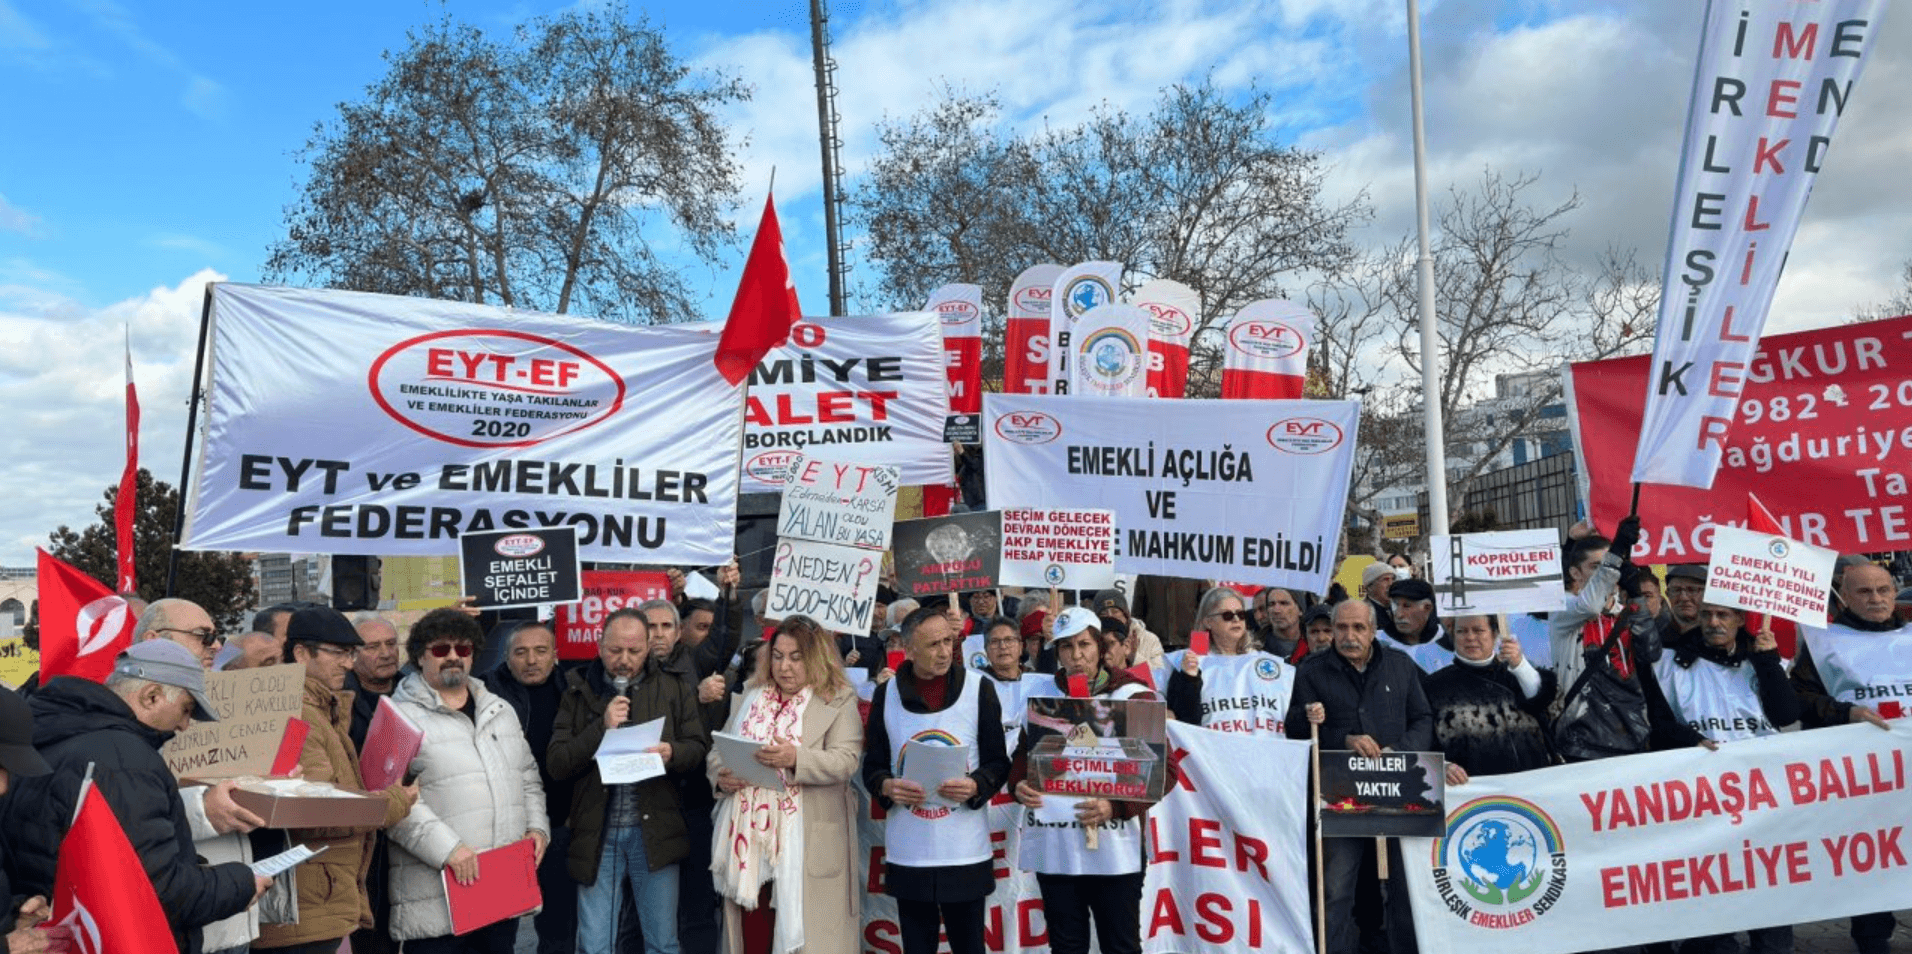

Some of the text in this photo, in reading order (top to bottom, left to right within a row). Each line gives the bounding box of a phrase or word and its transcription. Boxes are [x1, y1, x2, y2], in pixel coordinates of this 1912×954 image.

[1697, 0, 1820, 452] MEKLİLER
[1249, 325, 1287, 338] EYT
[427, 348, 580, 387] EYT-EF
[400, 384, 599, 408] EMEKLİLİKTE YAŞA TAKILANLAR
[407, 401, 588, 420] VE EMEKLİLER FEDERASYONU
[471, 419, 531, 437] 2020
[1012, 415, 1044, 427] EYT
[1286, 423, 1324, 435] EYT
[745, 426, 893, 450] BORÇLANDIK
[1717, 426, 1912, 473] ağduriye
[1067, 441, 1253, 487] EMEKLİ AÇLIĞA
[239, 453, 350, 494] EYT
[366, 466, 422, 493] ve
[438, 458, 709, 504] EMEKLİLER
[1146, 490, 1176, 520] VE
[782, 502, 838, 538] YALAN
[1004, 509, 1110, 523] SEÇİM GELECEK
[1004, 523, 1111, 537] DEVRAN DÖNECEK
[1004, 537, 1110, 550] AKP EMEKLİYE
[1129, 529, 1234, 564] MAHKUM
[1242, 532, 1323, 574] EDİLDİ
[490, 555, 552, 574] EMEKLİ
[1004, 550, 1112, 564] HESAP VERECEK.
[1467, 550, 1554, 565] KÖPRÜLERİ
[1485, 564, 1539, 577] YIKTIK
[1731, 554, 1816, 583] EMEKLİ YILI
[484, 571, 558, 589] SEFALET
[912, 576, 992, 594] PATLATTIK
[1713, 566, 1826, 601] OLACAK DEDİNİZ
[494, 586, 550, 603] İÇİNDE
[1786, 593, 1825, 613] KEFEN
[1738, 595, 1799, 617] BİÇTİNİZ
[1201, 693, 1278, 715] BİRLEŞİK
[229, 719, 277, 740] CENAZE
[168, 744, 249, 774] NAMAZINA
[1052, 758, 1140, 775] SEÇİMLERİ
[1348, 754, 1407, 772] GEMİLERİ
[1044, 778, 1147, 798] BEKLİYORUZ
[1355, 781, 1401, 797] YAKTIK
[1580, 749, 1906, 824] YANDAŞA BALLI
[1600, 826, 1908, 908] EMEKLİYE YOK
[1432, 853, 1567, 929] BİRLEŞİK EMEKLİLER SENDİKASI
